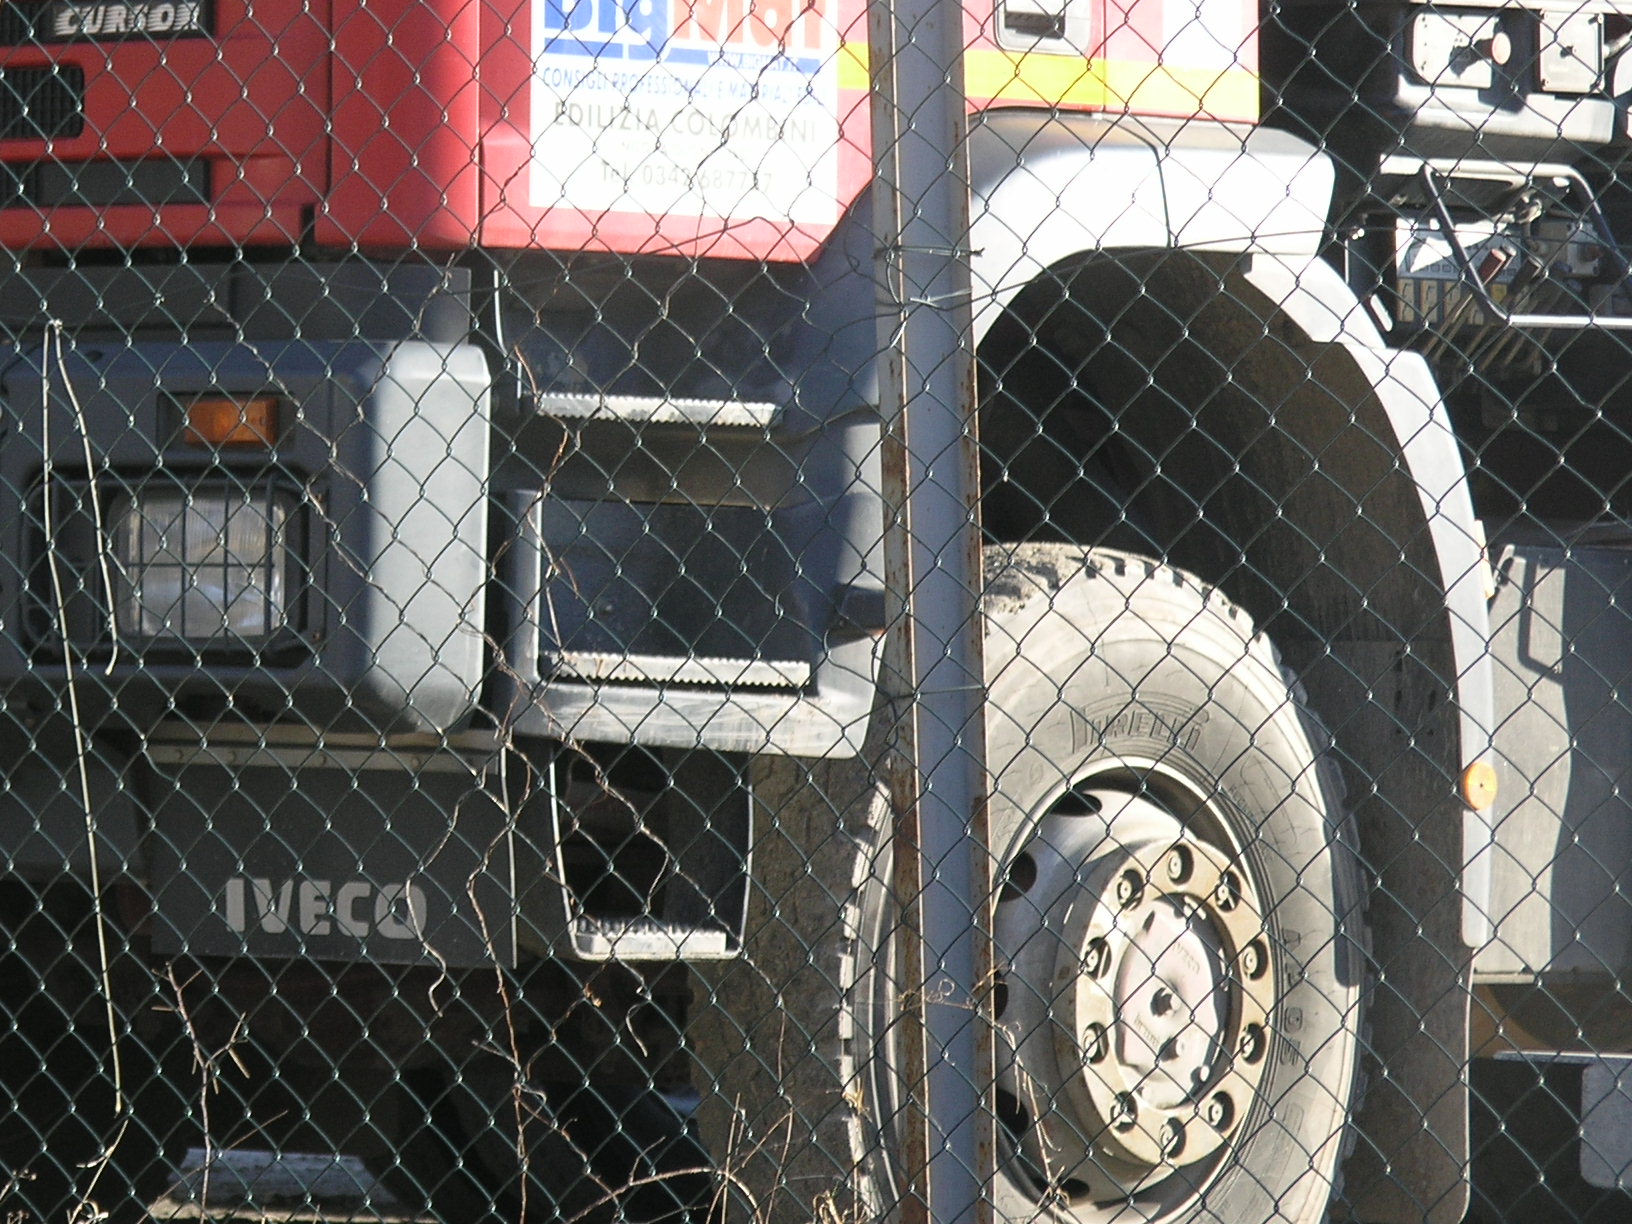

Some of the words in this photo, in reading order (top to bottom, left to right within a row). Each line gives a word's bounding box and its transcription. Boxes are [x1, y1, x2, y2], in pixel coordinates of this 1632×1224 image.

[53, 2, 200, 36] CURSOR
[555, 102, 659, 132] EDILIZIA
[700, 169, 772, 192] 68777
[226, 877, 426, 940] IVECO
